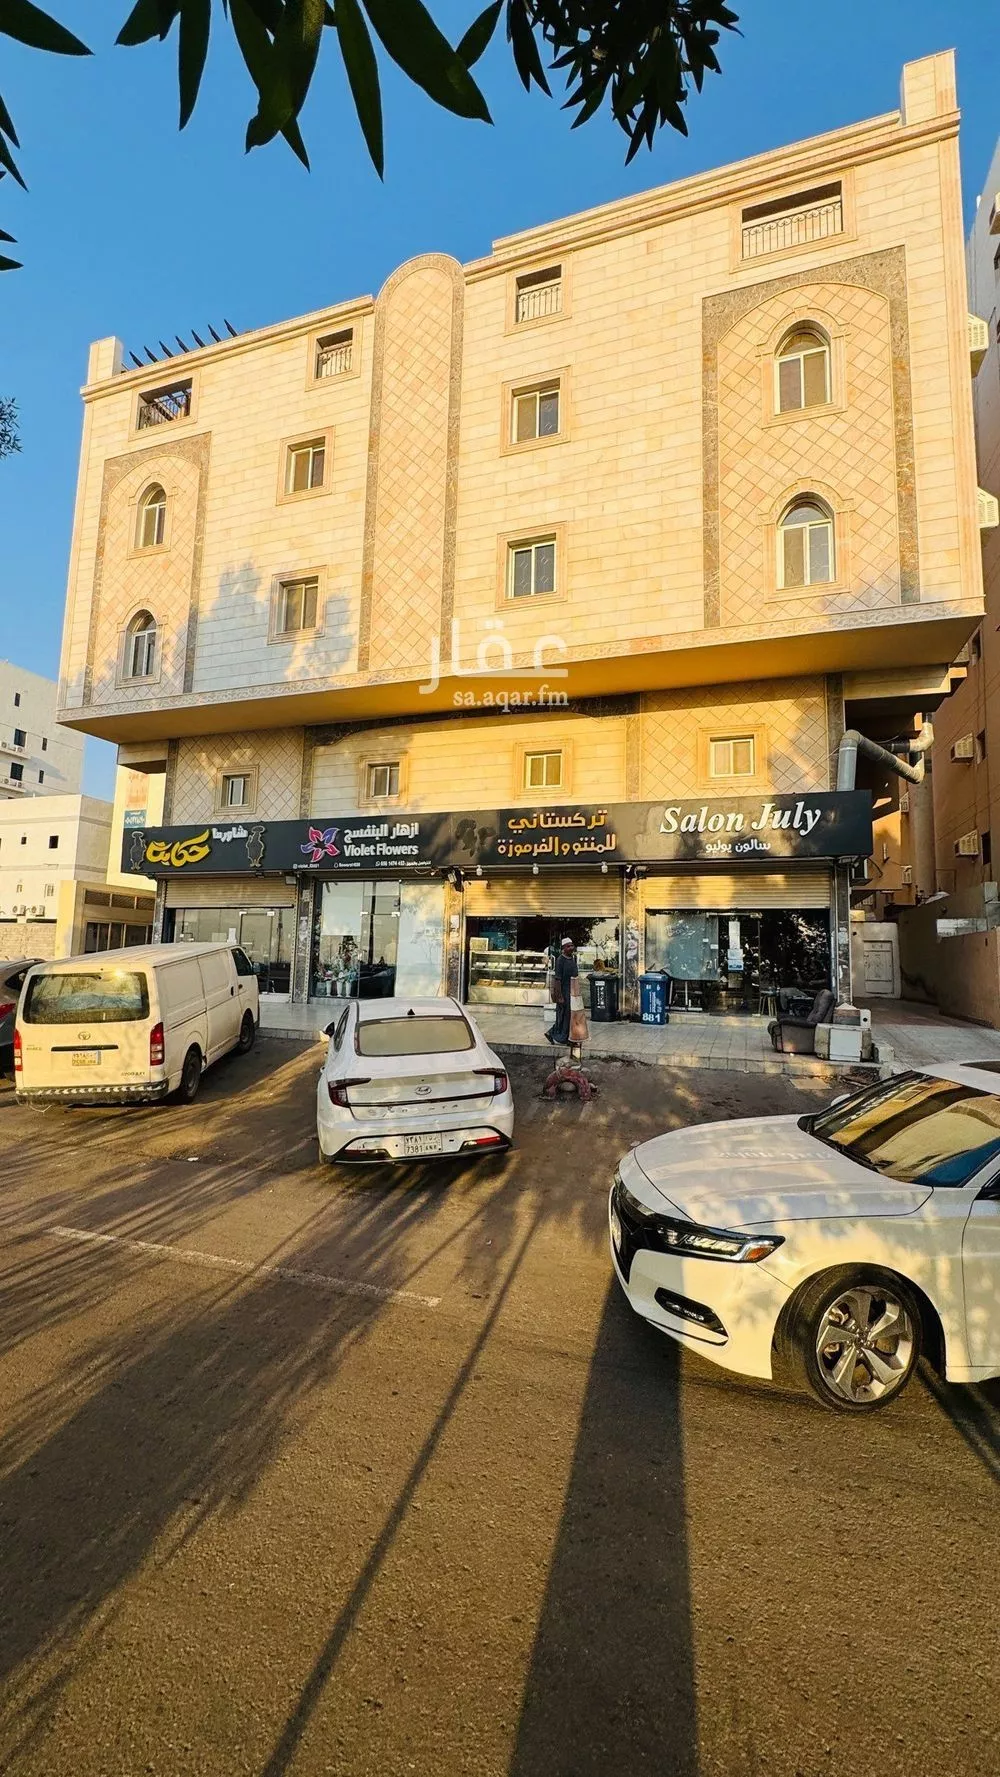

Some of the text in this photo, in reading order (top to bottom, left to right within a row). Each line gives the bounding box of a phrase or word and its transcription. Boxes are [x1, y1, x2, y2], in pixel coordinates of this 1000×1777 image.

[508, 809, 608, 834] تركستاني
[660, 801, 822, 836] Salon July
[212, 825, 248, 842] شاورما
[343, 822, 419, 843] ازهار البنفسج
[344, 842, 419, 857] Violet Flowers
[705, 839, 771, 853] سالون يوليو
[642, 1012, 661, 1022] 881
[406, 1144, 423, 1153] 7381
